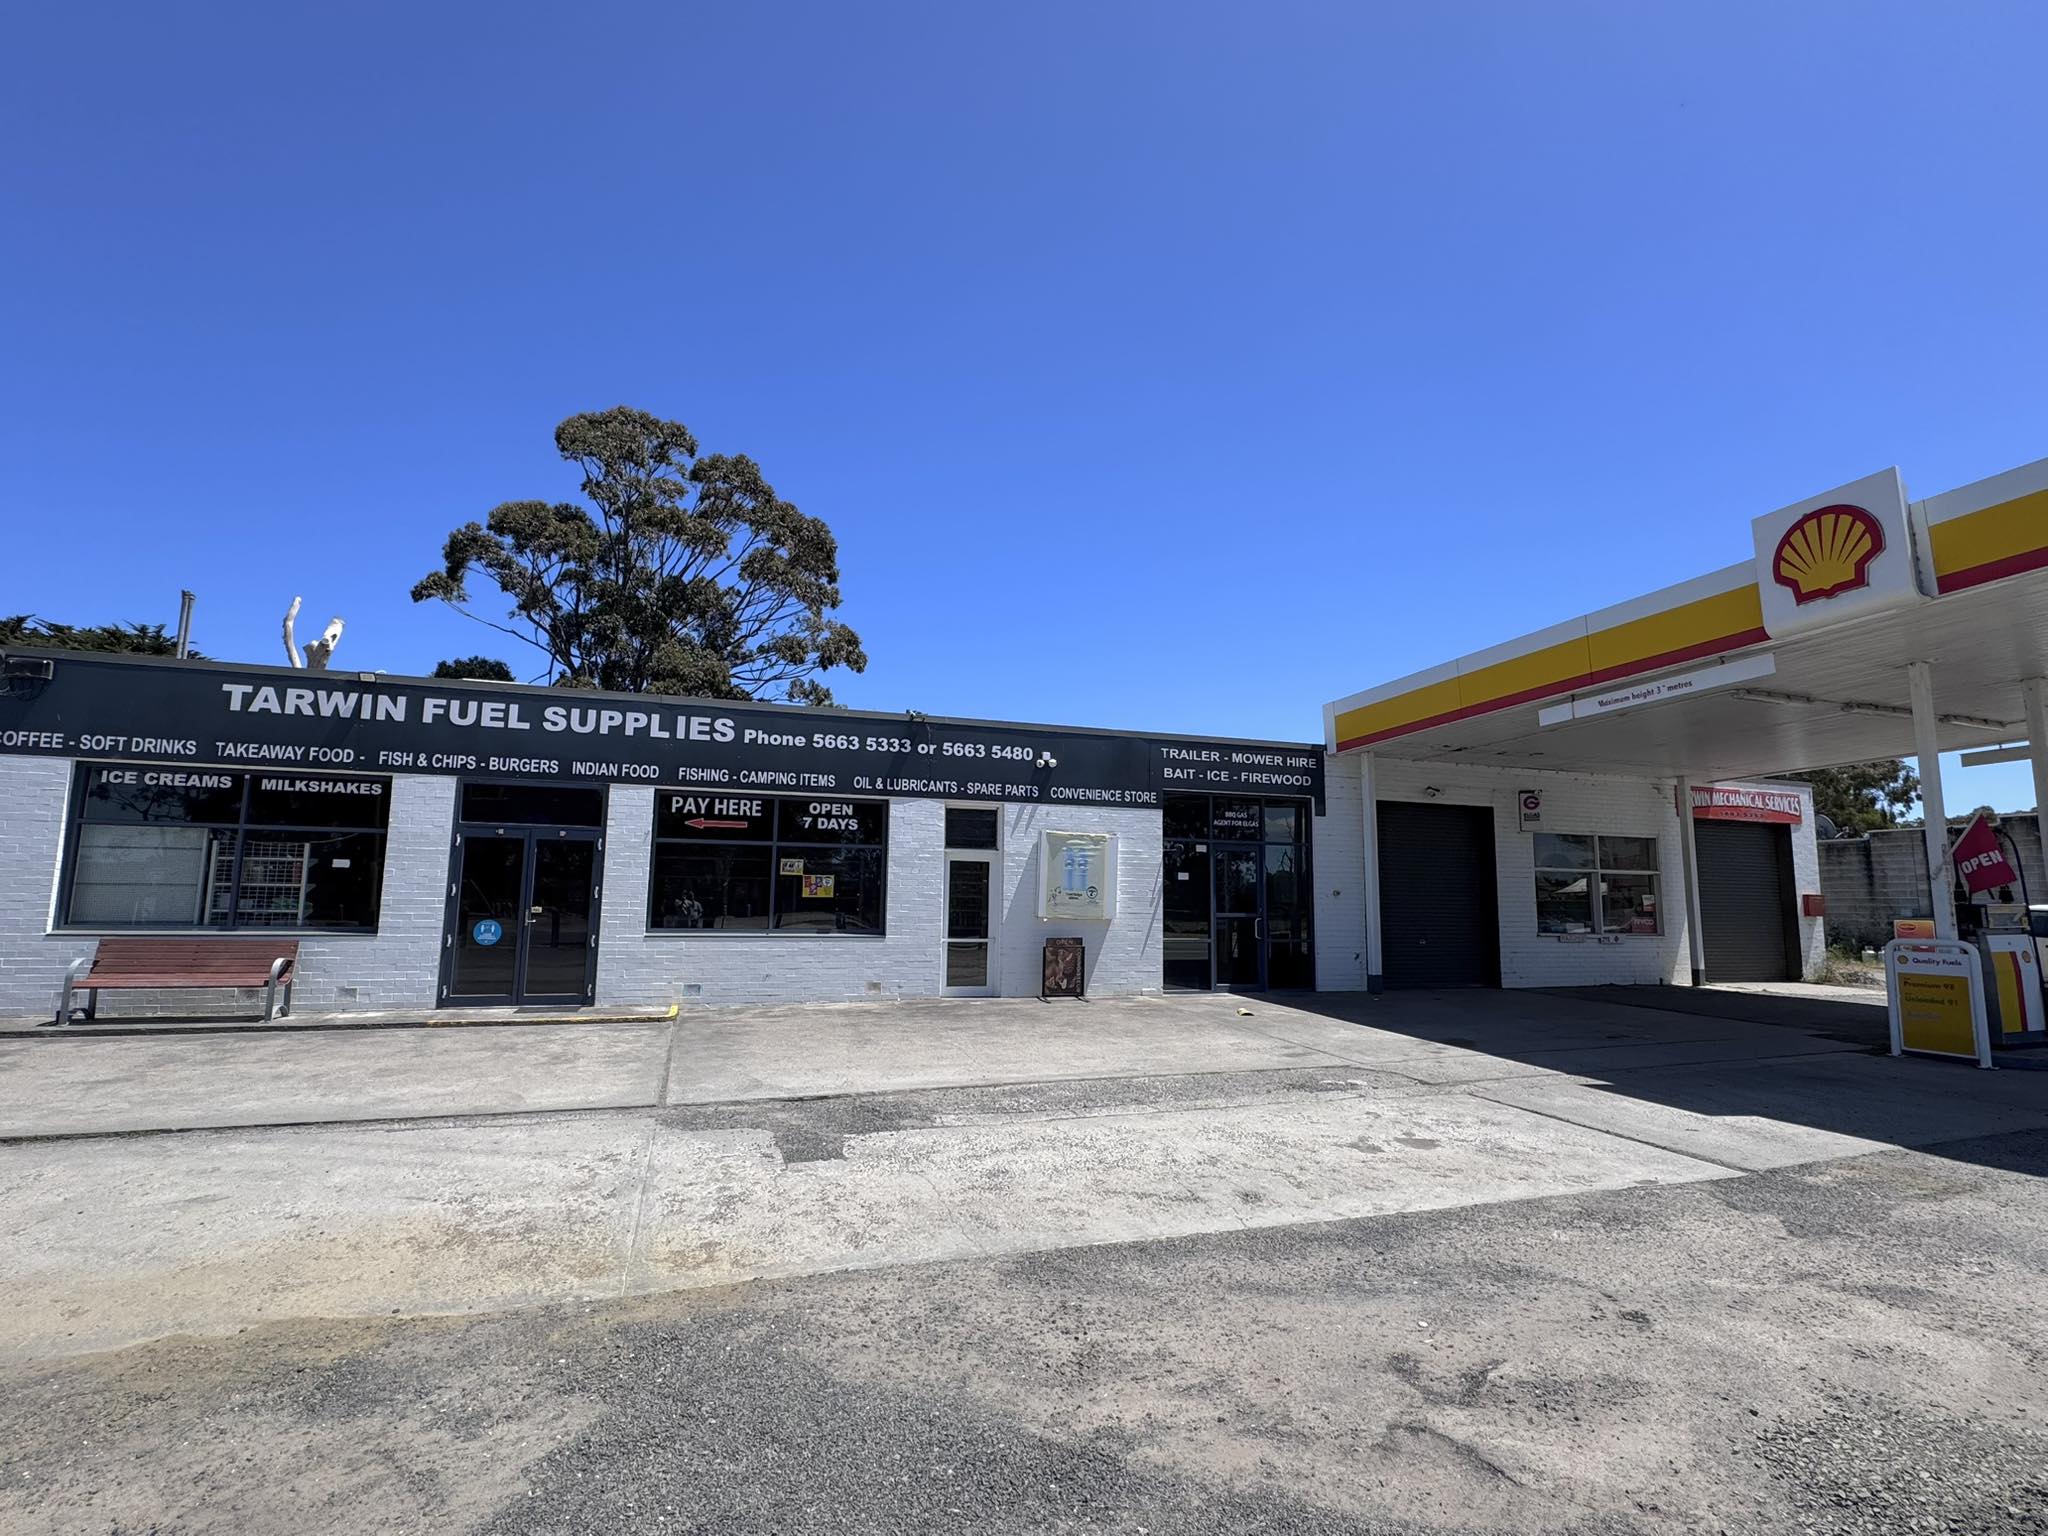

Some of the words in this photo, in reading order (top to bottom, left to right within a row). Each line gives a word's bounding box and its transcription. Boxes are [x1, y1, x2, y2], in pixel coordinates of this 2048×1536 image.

[1598, 695, 1631, 707] Maximum
[1631, 688, 1655, 700] height
[1667, 680, 1693, 692] metres
[222, 684, 406, 721] TARWIN
[423, 698, 530, 729] FUEL
[543, 707, 734, 742] SUPPLIES
[743, 728, 807, 747] Phone
[812, 733, 860, 750] 5663
[865, 736, 912, 753] 5333
[917, 743, 937, 755] or
[942, 742, 986, 758] 5663
[991, 745, 1034, 761] 5480
[0, 730, 64, 748] OFFEE
[79, 734, 128, 752] SOFT
[131, 737, 197, 755] DRINKS
[216, 742, 304, 760] TAKEAWAY
[308, 746, 355, 763] FOOD
[378, 750, 414, 767] FISH
[416, 752, 428, 767] &
[431, 753, 477, 770] CHIPS
[488, 756, 559, 774] BURGERS
[1160, 747, 1221, 762] TRAILER
[1231, 752, 1284, 767] MOWER
[1286, 756, 1317, 769] HIRE
[100, 770, 138, 785] ICE
[143, 772, 232, 789] CREAMS
[572, 761, 618, 777] INDIAN
[621, 763, 660, 779] FOOD
[678, 767, 729, 782] FISHING
[739, 770, 797, 786] CAMPING
[799, 773, 836, 788] ITEMS
[1163, 767, 1196, 780] BAIT
[1207, 770, 1230, 782] ICE
[1240, 771, 1312, 786] FIREWOOD
[261, 778, 382, 795] MILKSHAKES
[853, 775, 873, 789] OIL
[875, 777, 884, 790] &
[886, 778, 958, 794] LUBRICANTS
[966, 782, 1003, 796] SPARE
[1004, 784, 1039, 798] PARTS
[1050, 786, 1122, 802] CONVENIENCE
[1124, 790, 1157, 804] STORE
[671, 796, 711, 814] PAY
[714, 798, 762, 817] HERE
[808, 802, 853, 816] OPEN
[1712, 790, 1765, 809] MECHANICAL
[1765, 795, 1800, 816] SERVICES
[802, 816, 813, 829] 7
[817, 817, 859, 831] DAYS
[1224, 811, 1237, 819] BBQ
[1237, 811, 1248, 819] GAS
[1243, 820, 1259, 828] ELGAS
[1961, 850, 2004, 874] OPEN
[1912, 956, 1940, 966] Quality
[1903, 980, 1941, 990] Premium
